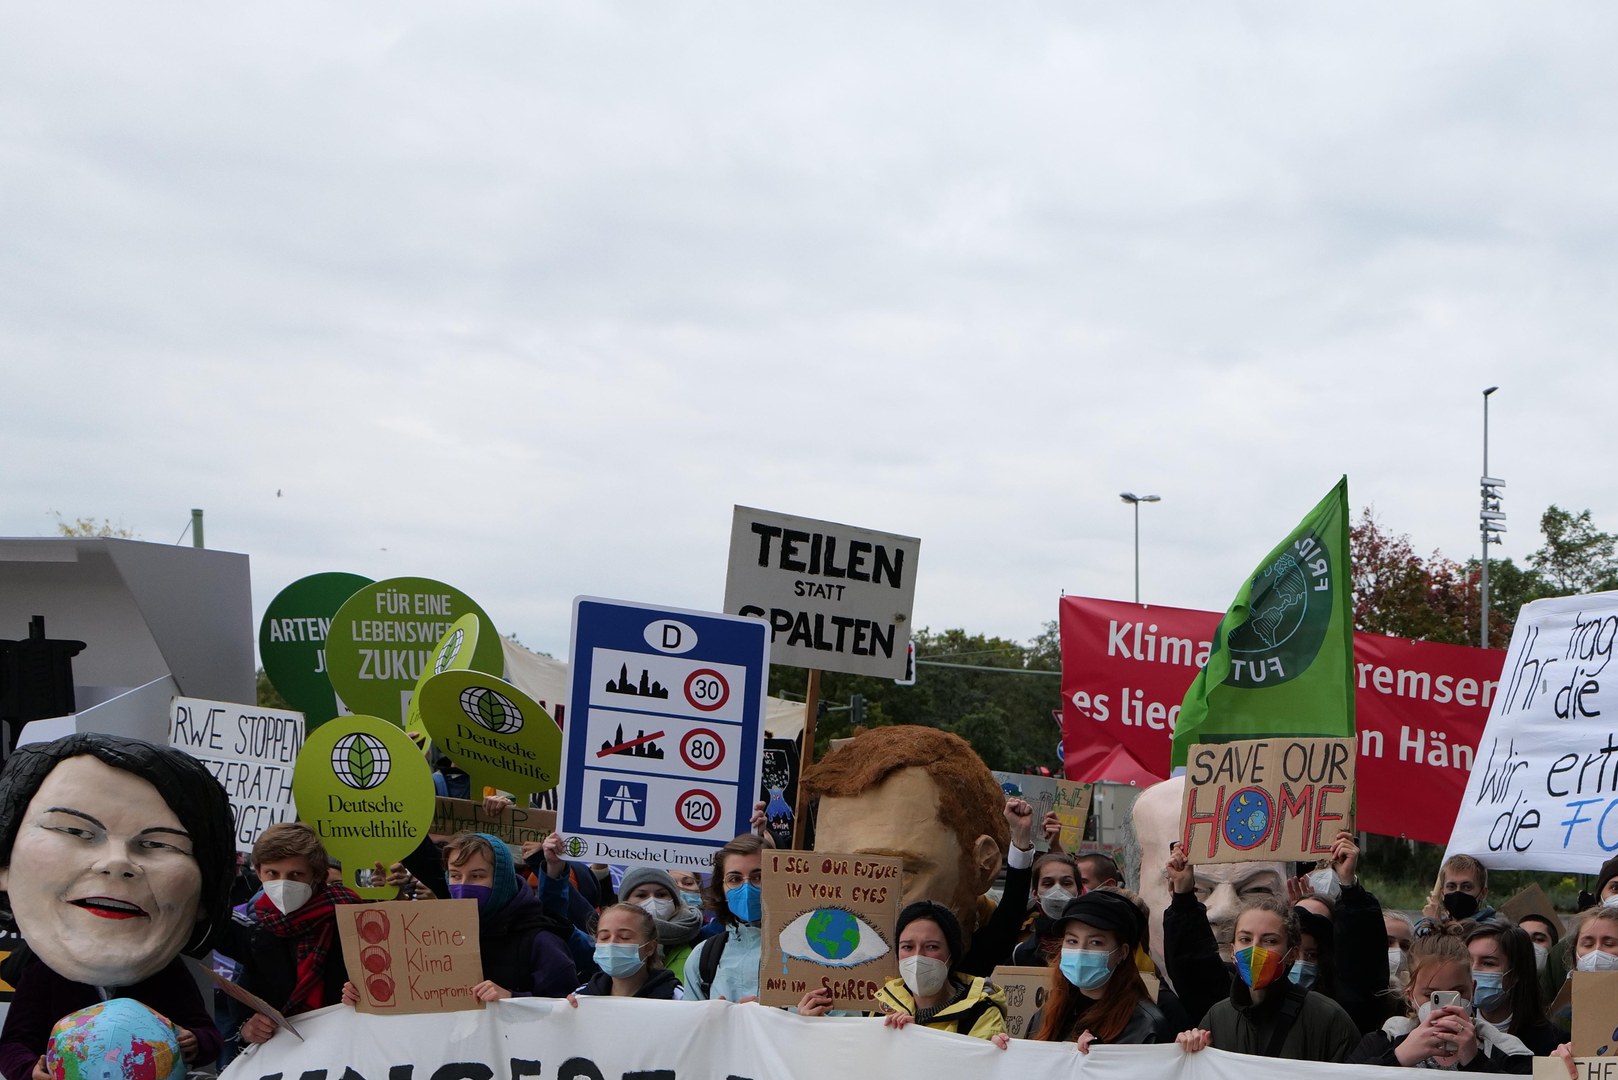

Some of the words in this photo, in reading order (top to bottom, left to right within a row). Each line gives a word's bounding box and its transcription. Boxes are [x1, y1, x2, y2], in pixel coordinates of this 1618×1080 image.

[751, 521, 904, 589] TEILEN
[376, 588, 409, 615] FÜR
[415, 594, 452, 616] EINE
[794, 580, 846, 601] STATT
[352, 620, 453, 643] LEBENSWE
[661, 624, 682, 649] D
[358, 649, 433, 680] ZUKU
[1107, 619, 1212, 669] Klima
[1354, 662, 1500, 709] remsen
[1501, 624, 1558, 716] Ihr
[694, 679, 719, 700] 30
[1554, 665, 1600, 720] die
[1071, 690, 1109, 722] es
[173, 706, 226, 750] RWE
[235, 715, 303, 763] STOPPEN
[457, 723, 537, 761] Deutsche
[690, 739, 715, 760] 80
[445, 738, 551, 783] Umwelthilfe
[1191, 743, 1269, 786] SAVE
[1282, 742, 1349, 785] OUR
[1475, 737, 1529, 806] Wir
[200, 759, 293, 805] ZERATH
[327, 794, 404, 813] Deutsche
[684, 800, 714, 821] 120
[317, 819, 417, 838] Umwelthilfe
[1184, 784, 1346, 858] HOME
[1487, 789, 1541, 852] die
[595, 843, 662, 863] Deutsche
[772, 857, 779, 873] I
[821, 859, 848, 876] OUR
[854, 861, 898, 878] FUTURE
[787, 883, 802, 898] IN
[808, 883, 842, 899] YOUR
[852, 886, 887, 903] EYES
[401, 912, 464, 946] Keine
[405, 947, 453, 975] Klima
[408, 975, 474, 1007] Kompromis
[766, 978, 787, 991] AND
